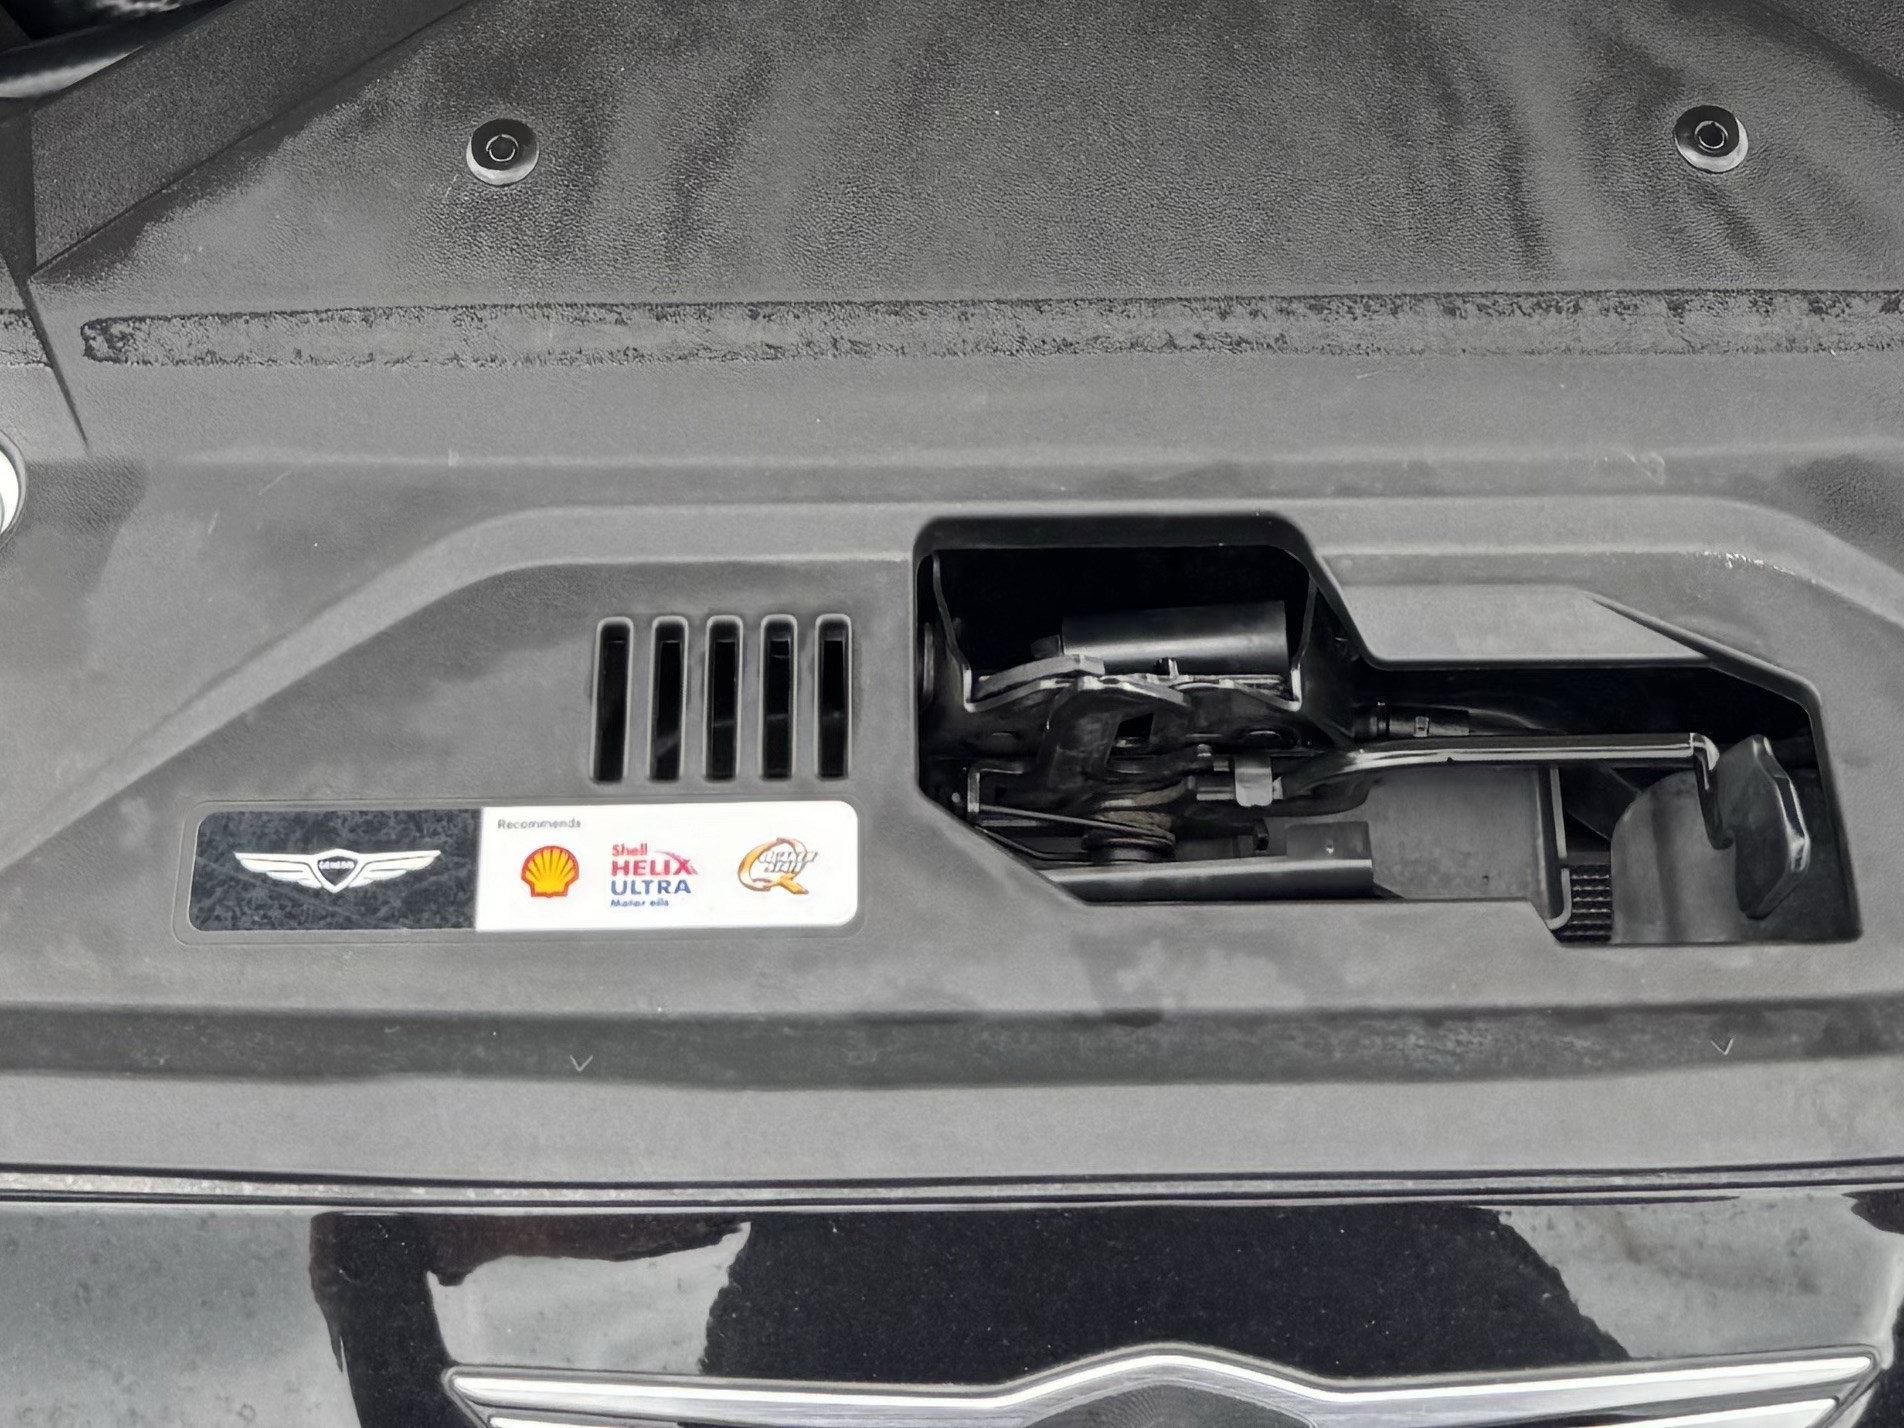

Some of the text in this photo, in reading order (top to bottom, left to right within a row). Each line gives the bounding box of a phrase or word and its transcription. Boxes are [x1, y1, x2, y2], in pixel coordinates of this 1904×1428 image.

[611, 842, 649, 858] Shell
[610, 858, 698, 877] HELIX
[610, 879, 693, 897] ULTRA
